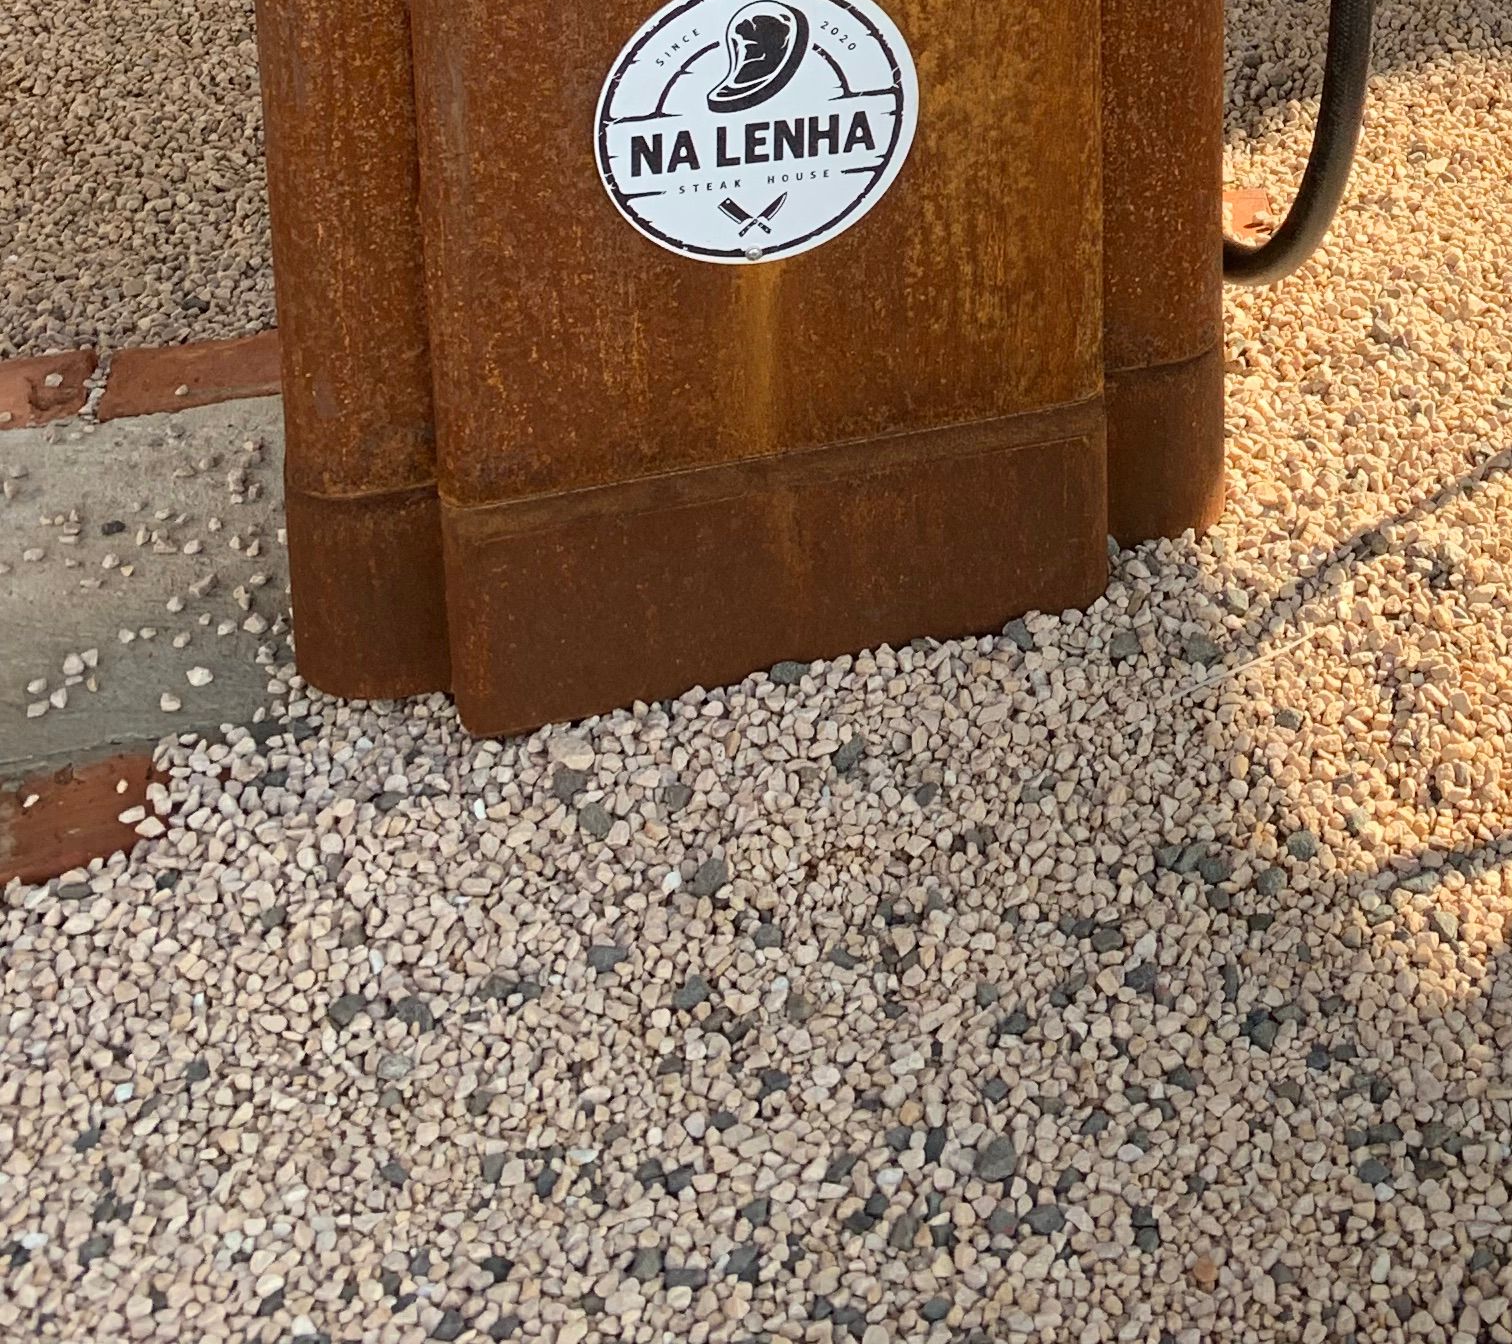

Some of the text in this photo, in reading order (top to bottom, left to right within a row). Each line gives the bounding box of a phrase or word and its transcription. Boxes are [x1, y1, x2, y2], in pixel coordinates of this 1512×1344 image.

[656, 20, 858, 67] SINCE 2020
[630, 111, 876, 178] NA LENHA
[679, 169, 831, 194] STEAK HOUSE
